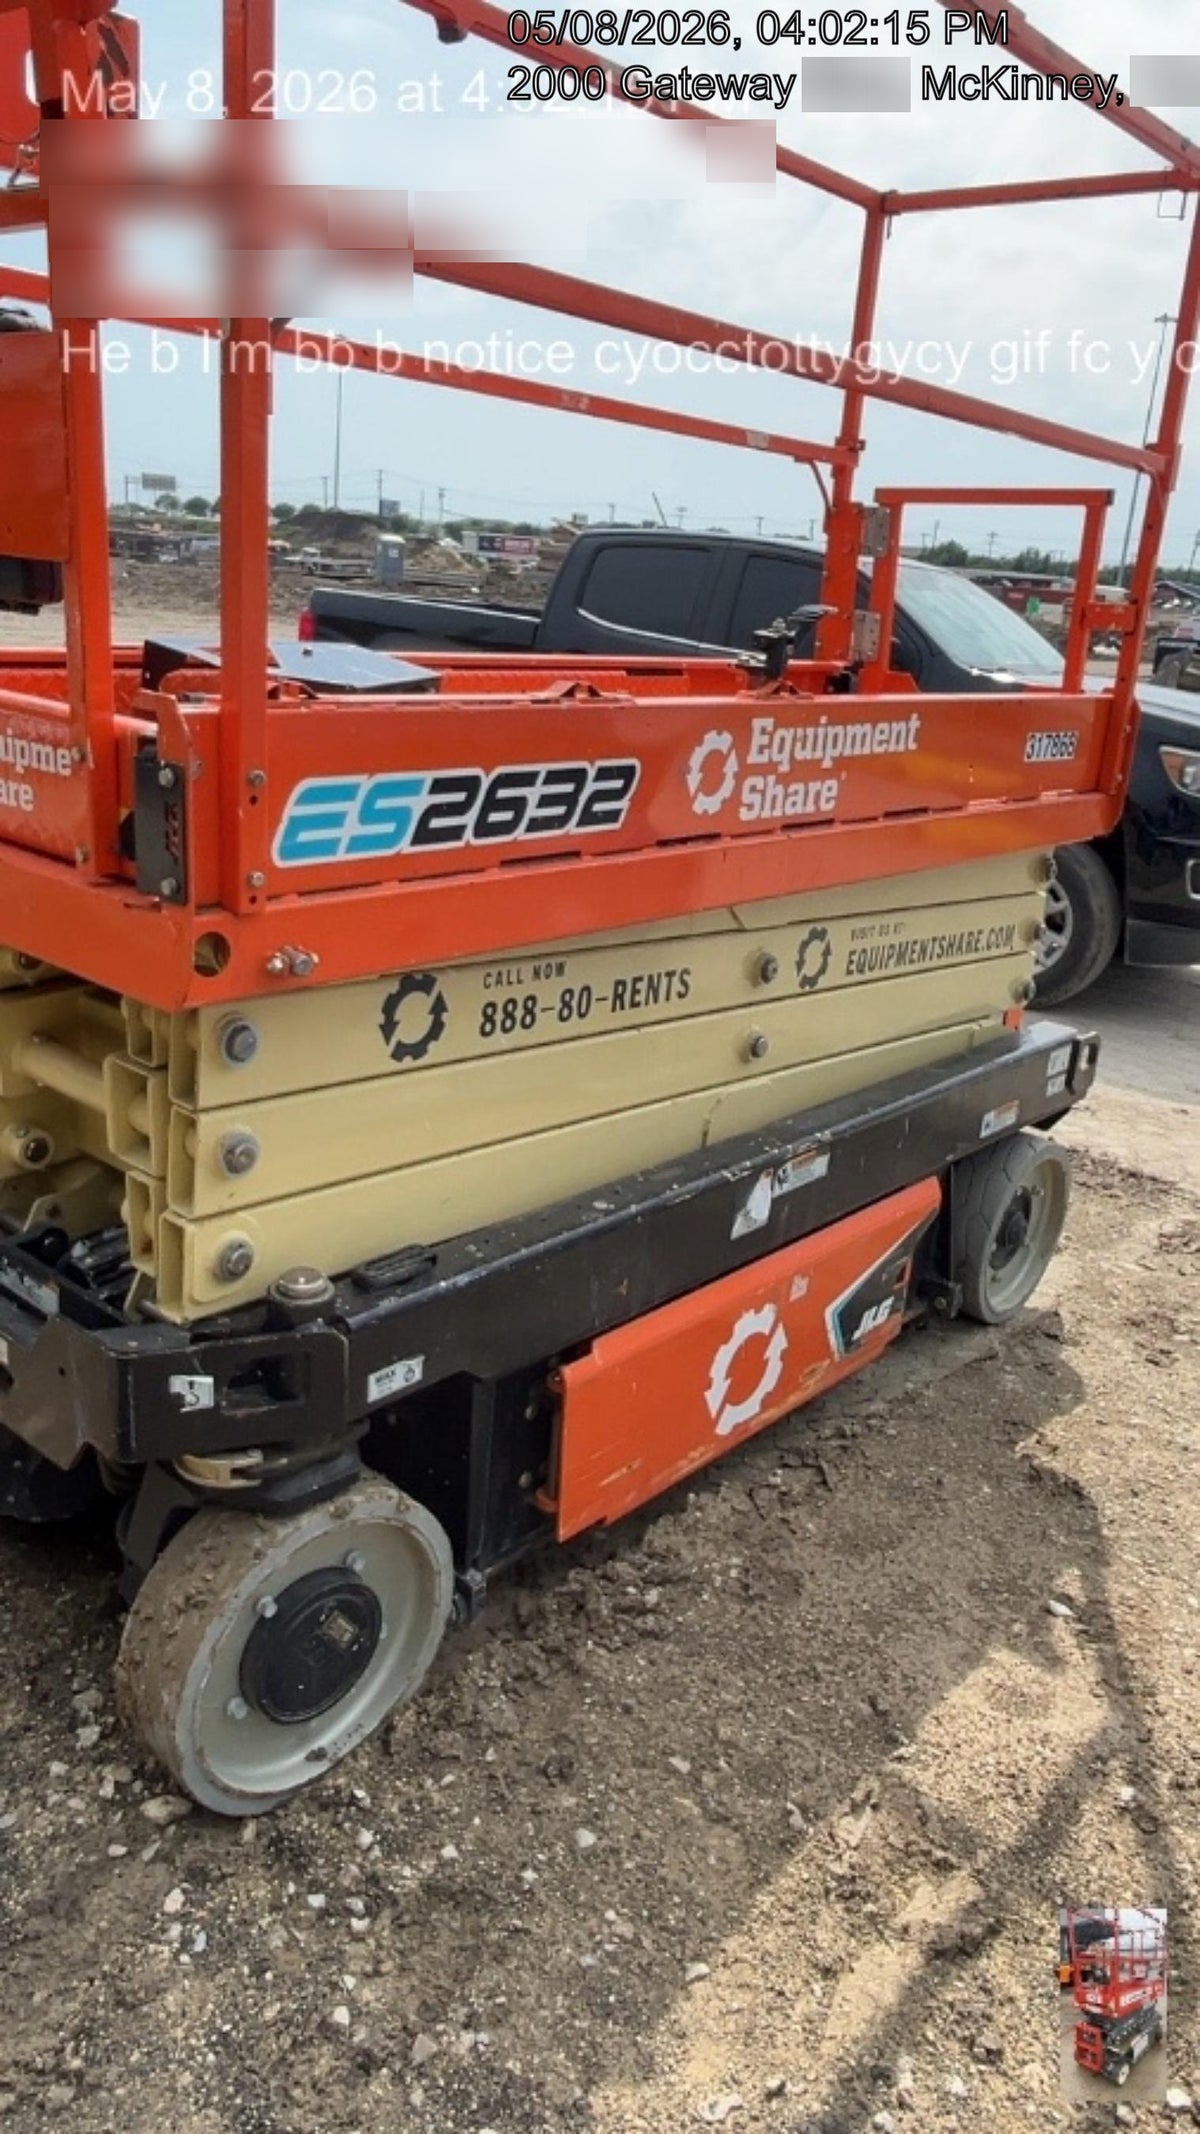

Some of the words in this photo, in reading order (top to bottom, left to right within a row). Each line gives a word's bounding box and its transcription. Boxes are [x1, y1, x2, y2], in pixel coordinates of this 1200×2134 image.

[747, 712, 922, 774] Equipment
[275, 761, 639, 865] ES2632
[739, 775, 839, 822] Share
[482, 967, 524, 990] CALL
[532, 960, 568, 982] NOW
[845, 923, 1017, 977] EQUIPMENTSHARE.COM
[479, 967, 692, 1038] 888-80-RENTS
